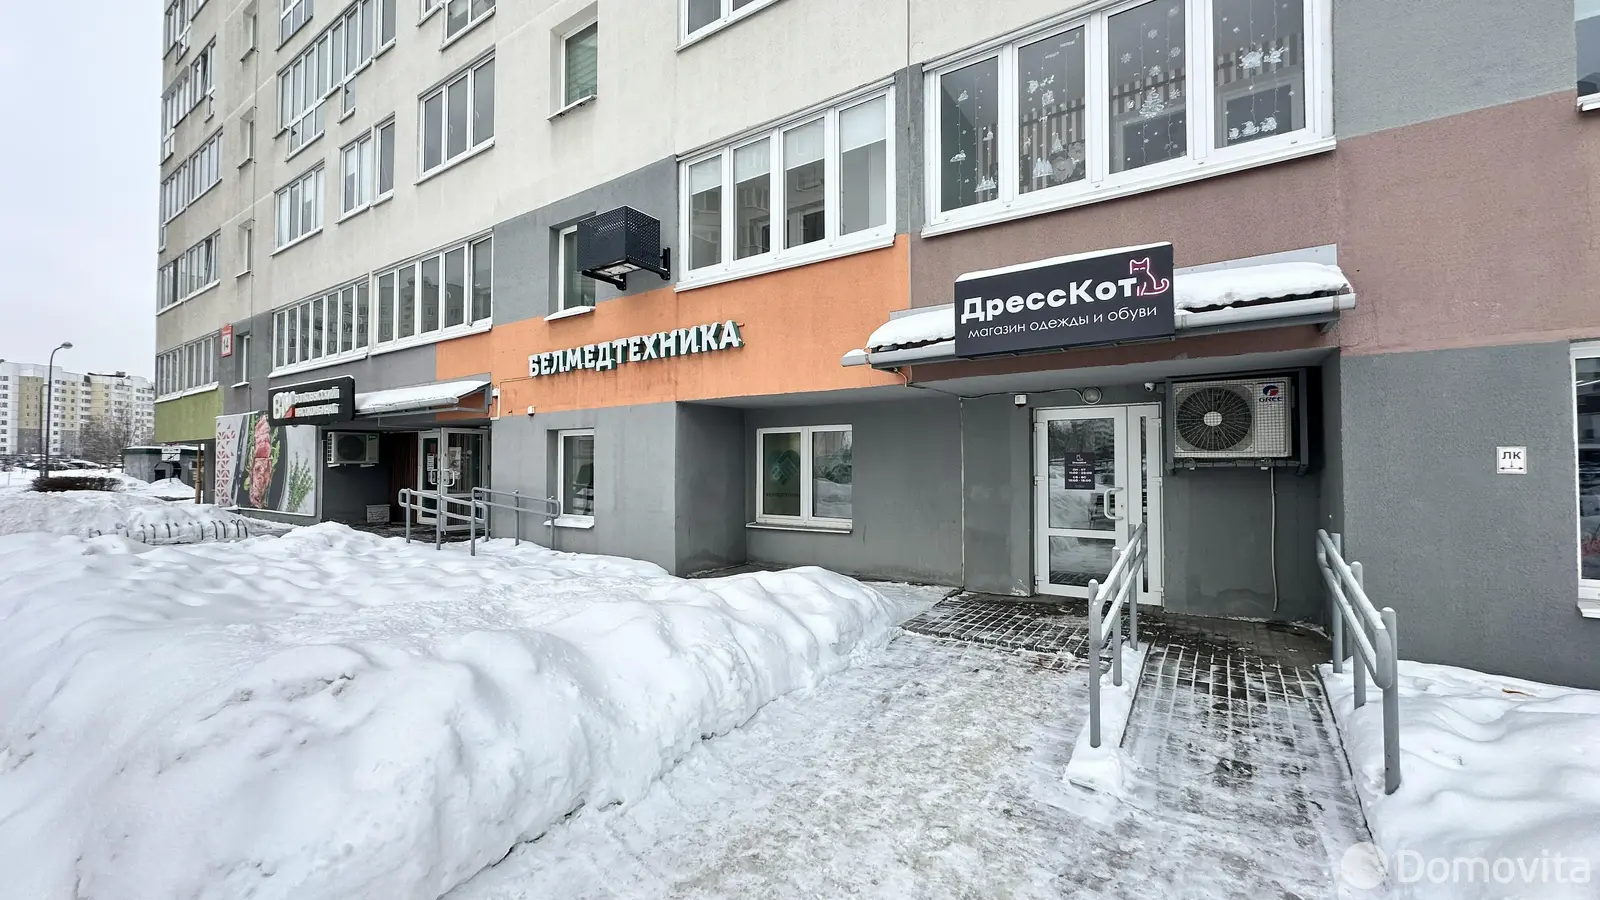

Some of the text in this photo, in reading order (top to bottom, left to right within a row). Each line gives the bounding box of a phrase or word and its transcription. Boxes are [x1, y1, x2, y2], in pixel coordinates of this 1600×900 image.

[960, 277, 1138, 325] ДрессКот
[968, 305, 1158, 339] магазин одежды и обуви
[223, 336, 229, 351] 14
[527, 319, 744, 378] БЕЛМЕДТЕХНИКА
[1502, 451, 1522, 460] ЛК
